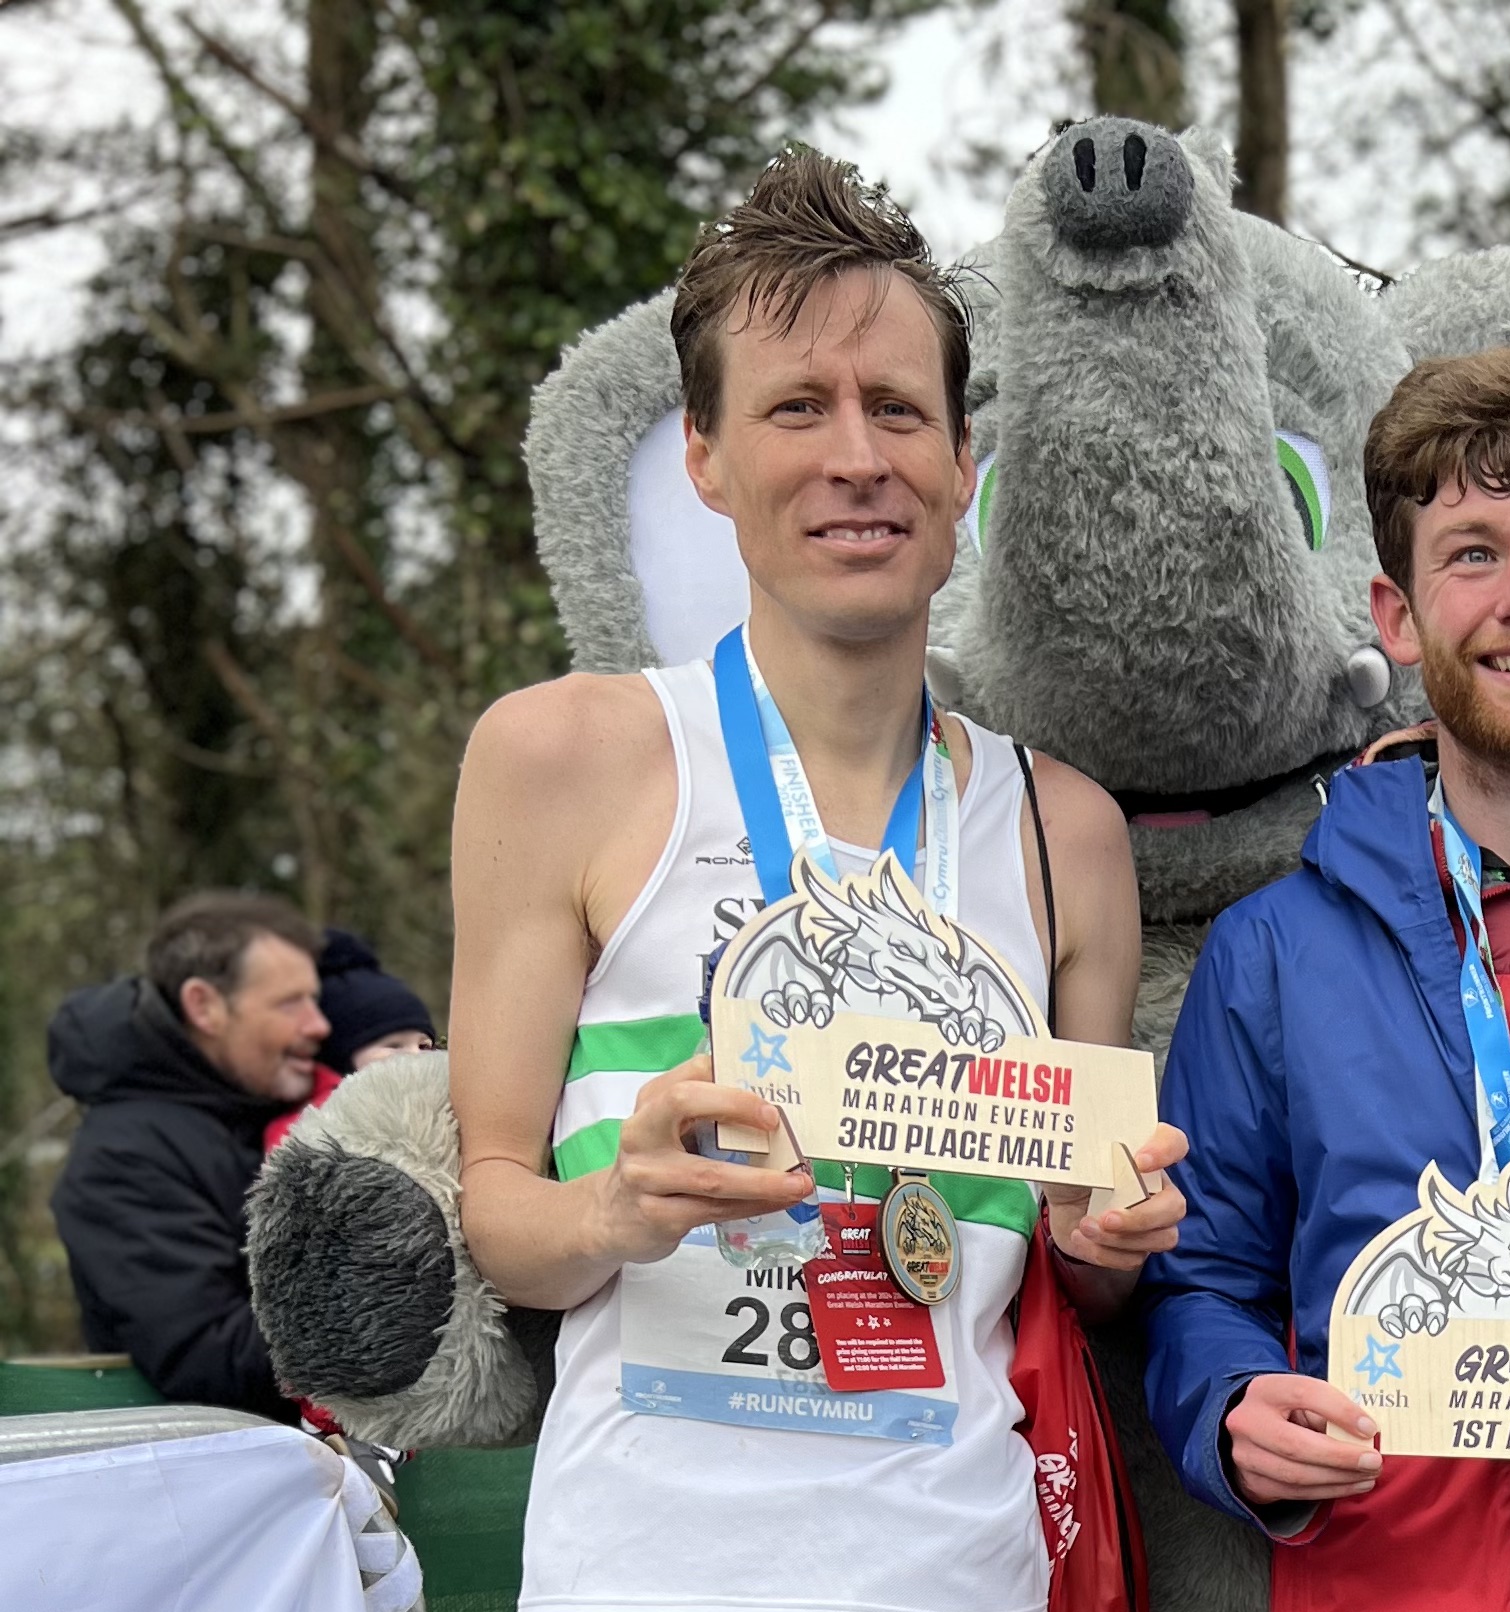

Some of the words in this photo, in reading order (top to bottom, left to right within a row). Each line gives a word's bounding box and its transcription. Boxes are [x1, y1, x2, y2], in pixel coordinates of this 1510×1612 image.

[779, 756, 820, 840] FINISHER
[842, 1087, 979, 1124] MARATHON
[989, 1101, 1076, 1134] EVENTS
[837, 1116, 897, 1152] 3RD
[904, 1126, 993, 1164] PLACE
[997, 1136, 1074, 1172] MALE
[841, 1228, 872, 1241] GREAT
[728, 1391, 873, 1421] #RUNCYMRU
[1451, 1419, 1503, 1449] 1ST
